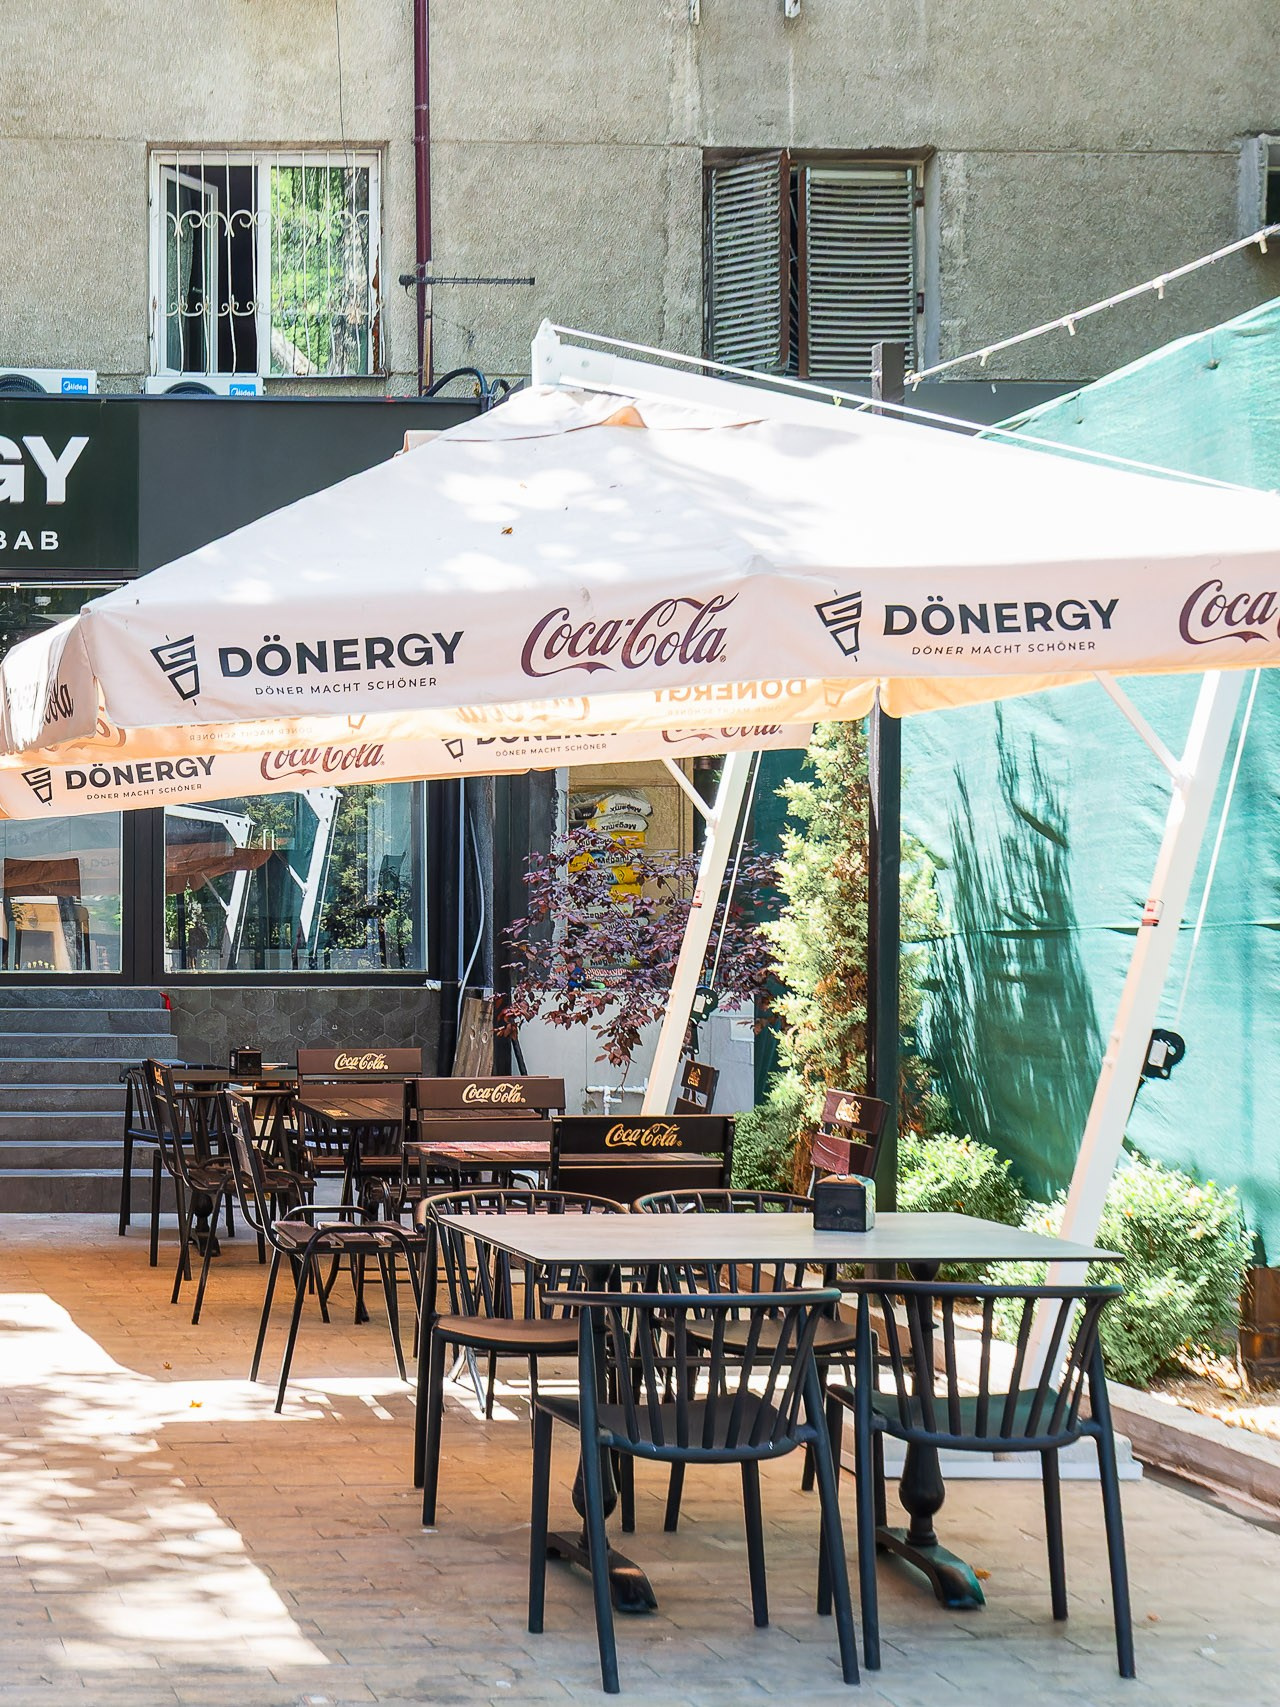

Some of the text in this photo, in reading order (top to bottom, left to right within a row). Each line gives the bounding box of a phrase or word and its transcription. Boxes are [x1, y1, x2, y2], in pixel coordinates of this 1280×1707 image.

[883, 595, 1120, 636] DÖNERGY
[1179, 579, 1280, 645] Coca
[521, 592, 739, 678] Coca-Cola
[911, 640, 1096, 655] DÖNER MACHT SCHÖNER
[218, 630, 465, 678] DÖNERGY
[254, 677, 438, 696] DÖNER MACHT SCHÖNER
[261, 743, 385, 781] CocaCola
[530, 746, 561, 754] MACHT
[65, 755, 216, 790] DÖNERGY
[123, 788, 155, 798] MACHT
[335, 1053, 387, 1070] Coca-Cola
[462, 1083, 524, 1103] Coca-Cola
[605, 1123, 680, 1148] Coca-Cola
